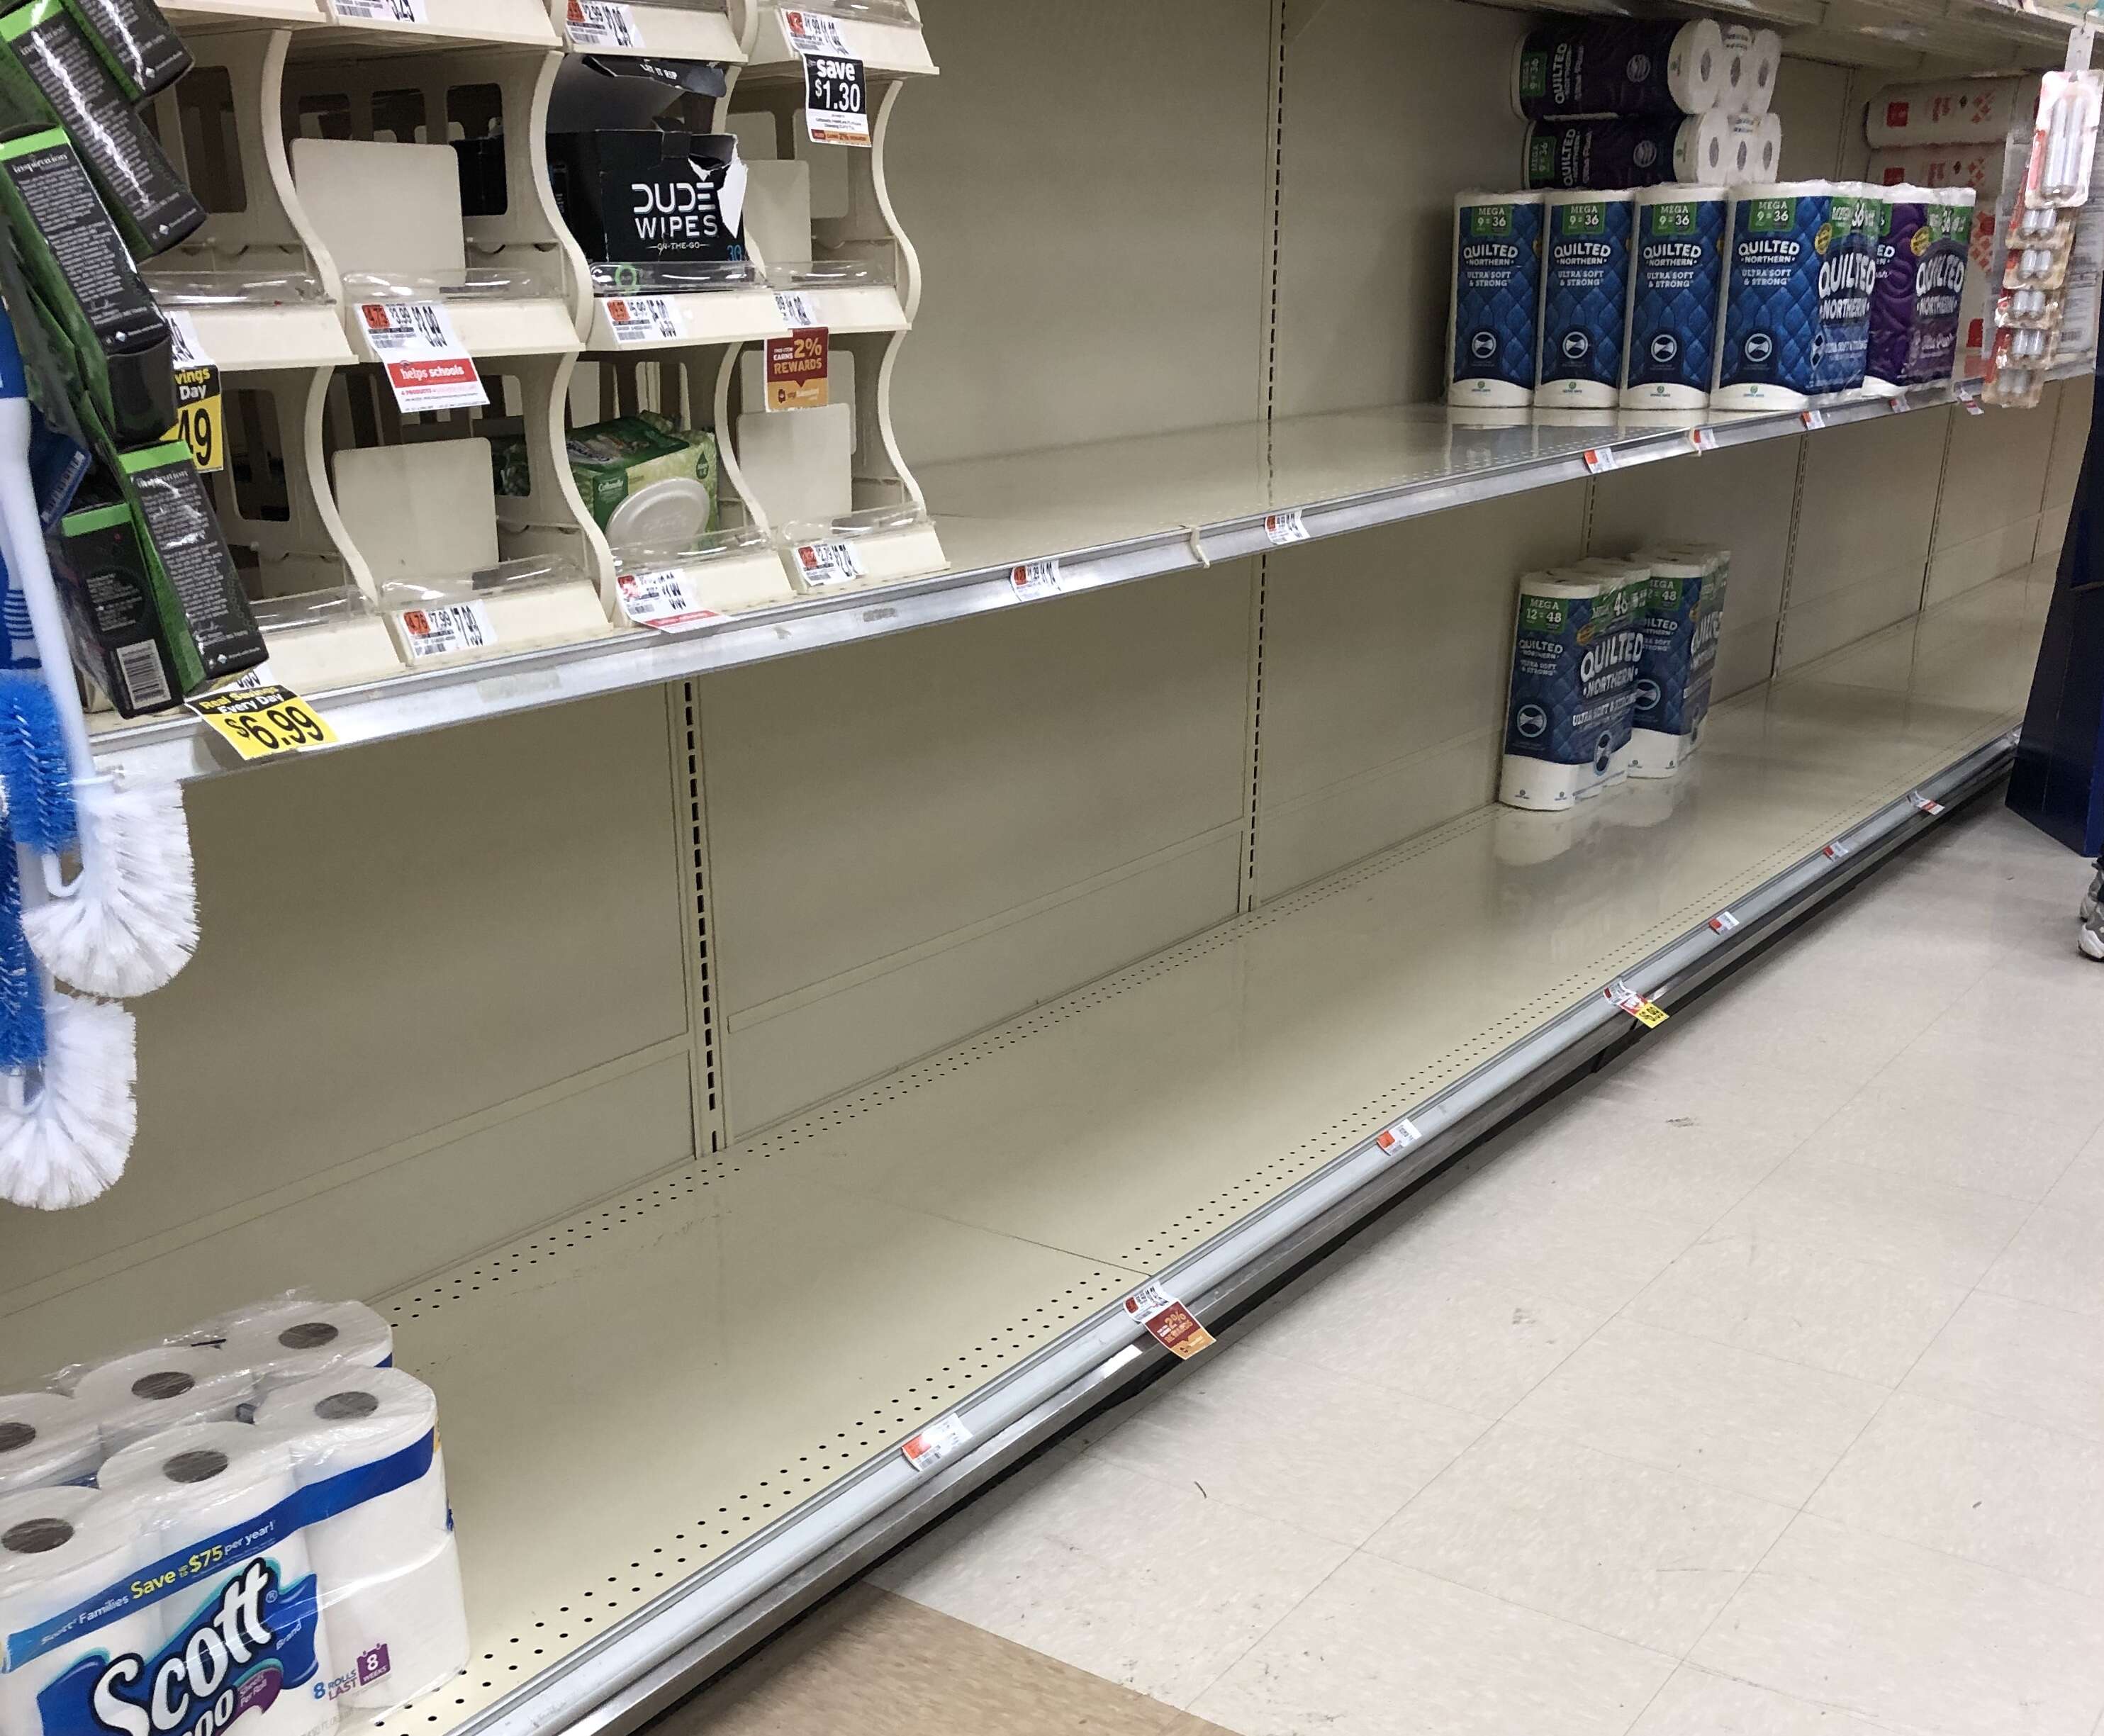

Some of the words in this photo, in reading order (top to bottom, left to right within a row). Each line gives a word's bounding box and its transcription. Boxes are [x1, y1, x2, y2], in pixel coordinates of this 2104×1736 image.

[816, 59, 856, 81] save
[1552, 43, 1567, 105] QUILTED
[815, 79, 861, 112] $1.30
[1561, 128, 1577, 186] QUILTED
[632, 181, 716, 213] DUDE
[1758, 201, 1787, 210] MEGA
[1477, 218, 1484, 226] 9
[1492, 217, 1506, 227] 36
[1569, 215, 1576, 225] 9
[1584, 214, 1599, 225] 36
[1659, 215, 1666, 225] 9
[1675, 214, 1690, 225] 36
[1757, 211, 1764, 221] 9
[1774, 211, 1789, 222] 36
[1852, 199, 1864, 227] 36
[634, 214, 718, 240] WIPES
[1463, 244, 1518, 259] QUILTED
[1554, 242, 1611, 258] QUILTED
[1643, 243, 1701, 259] QUILTED
[1738, 240, 1800, 256] QUILTED
[1745, 255, 1791, 264] NORTHERN
[1769, 269, 1791, 277] SOFT
[1818, 252, 1876, 298] QUILTED
[1915, 254, 1964, 297] QUILTED
[1823, 298, 1867, 320] NORTHERN
[1919, 295, 1956, 316] NORTHERN
[773, 353, 793, 362] EARNS
[794, 337, 822, 359] 2%
[174, 366, 211, 385] vings
[400, 367, 428, 381] helps
[429, 364, 465, 378] schools
[773, 357, 822, 375] REWARDS
[179, 383, 207, 401] Day
[1529, 598, 1560, 610] MEGA
[1662, 590, 1677, 601] 48
[428, 610, 452, 631] $7.99
[1526, 608, 1538, 620] 12
[1546, 611, 1562, 624] 48
[1518, 639, 1563, 654] QUILTED
[1580, 632, 1644, 683] QUILTED
[1587, 666, 1634, 698] NORTHERN
[198, 695, 232, 710] Real
[229, 685, 279, 702] Savings
[217, 699, 259, 715] Every
[255, 692, 285, 706] Day
[224, 705, 325, 749] $6.99
[79, 1595, 129, 1626] Families
[130, 1569, 176, 1601] Save
[189, 1544, 225, 1574] $75
[225, 1537, 245, 1556] per
[245, 1520, 275, 1547] year!
[276, 1618, 303, 1651] Brand
[94, 1562, 273, 1736] Scott
[369, 1654, 379, 1671] 8
[313, 1681, 326, 1700] 8
[328, 1669, 357, 1690] ROLLS
[362, 1665, 388, 1683] WEEKS
[240, 1691, 254, 1708] Per
[328, 1677, 358, 1701] LAST
